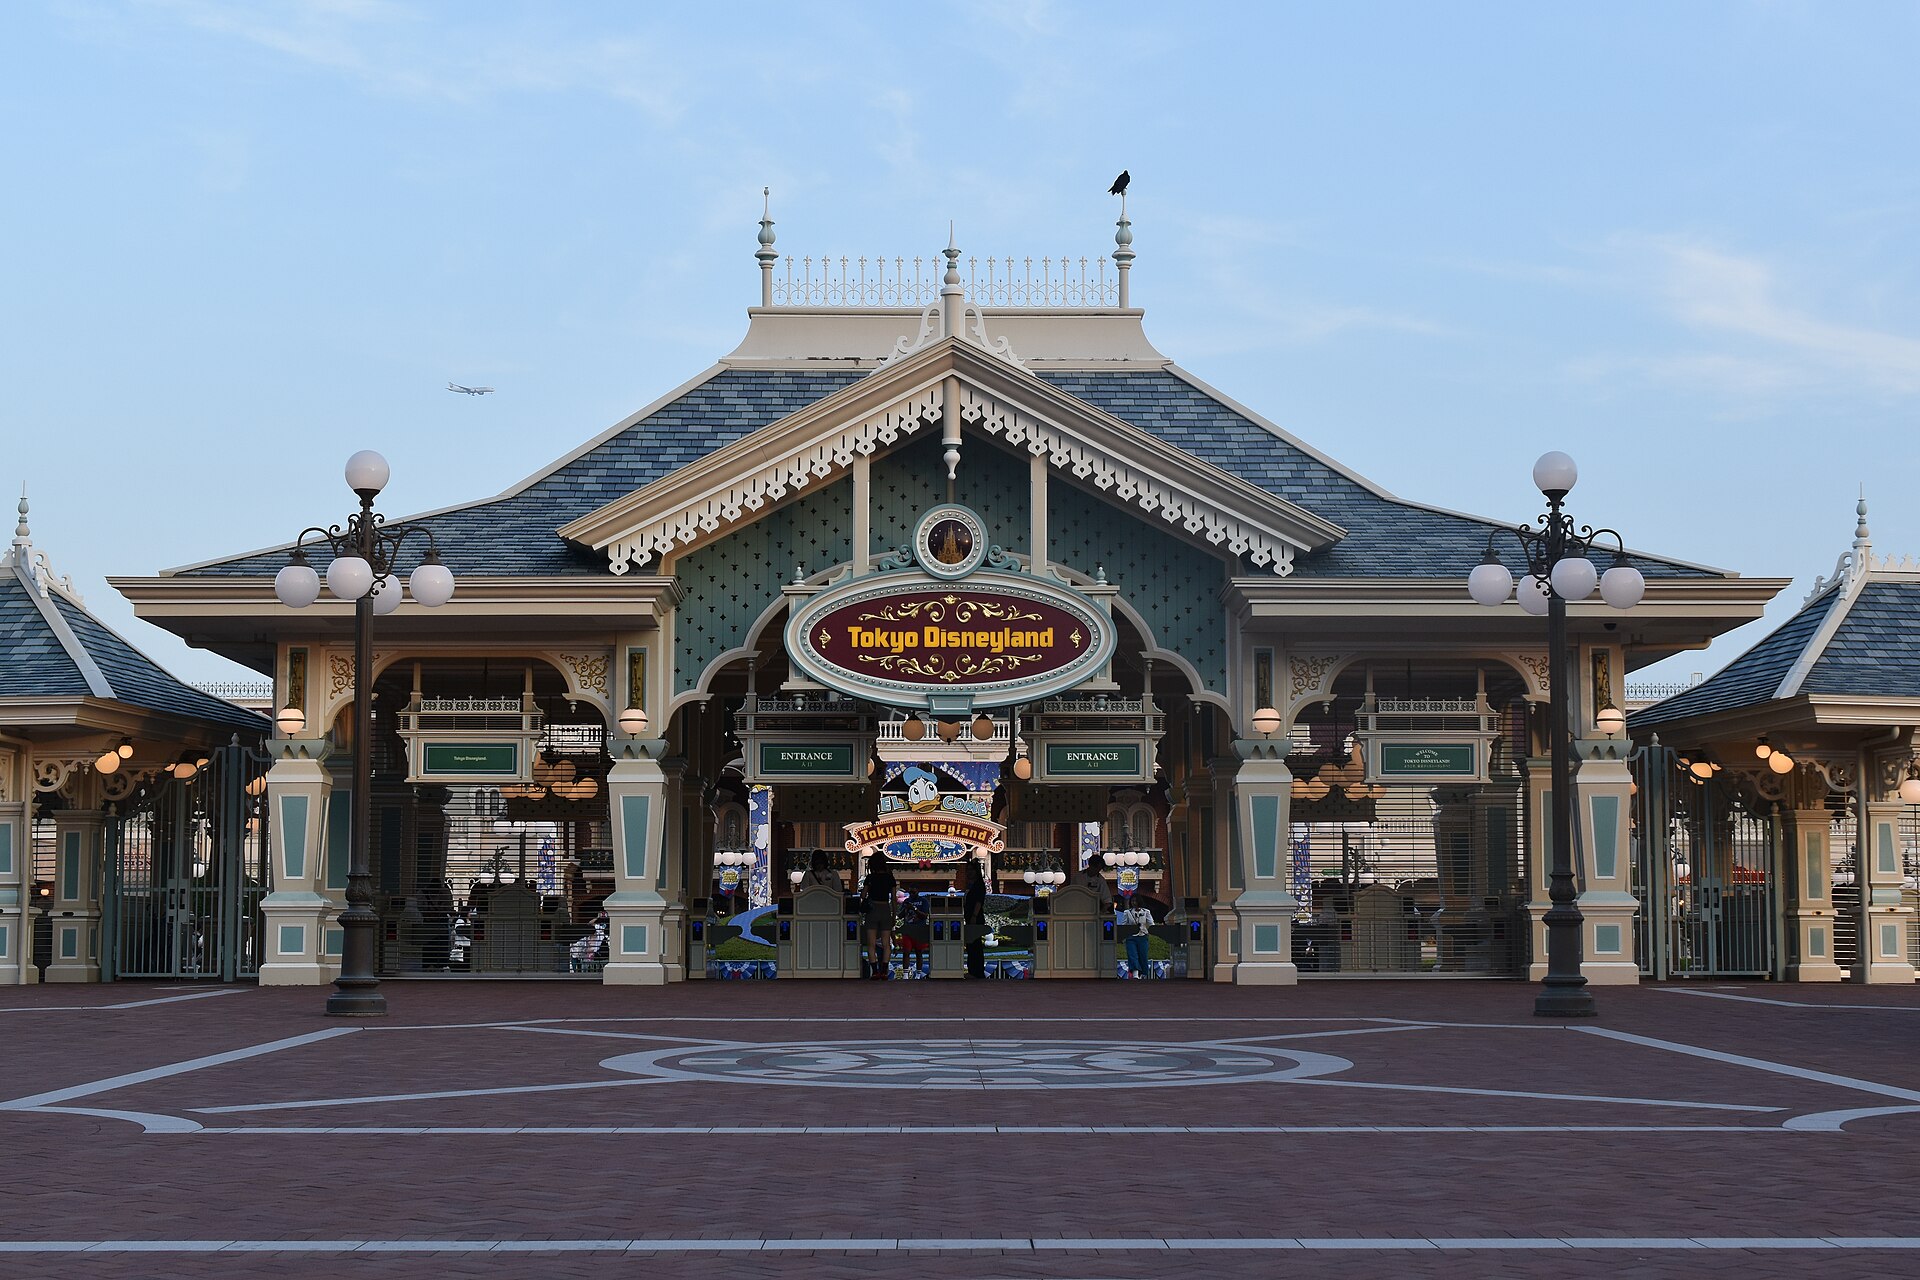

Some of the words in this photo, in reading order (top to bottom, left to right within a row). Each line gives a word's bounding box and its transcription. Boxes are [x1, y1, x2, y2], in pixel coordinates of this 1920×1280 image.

[847, 626, 918, 653] Tokyo
[924, 626, 1054, 653] Disneyland
[780, 752, 833, 760] ENTRANCE
[1066, 752, 1119, 760] ENTRANCE
[860, 825, 902, 841] Tokyo
[907, 821, 987, 841] Disneyland
